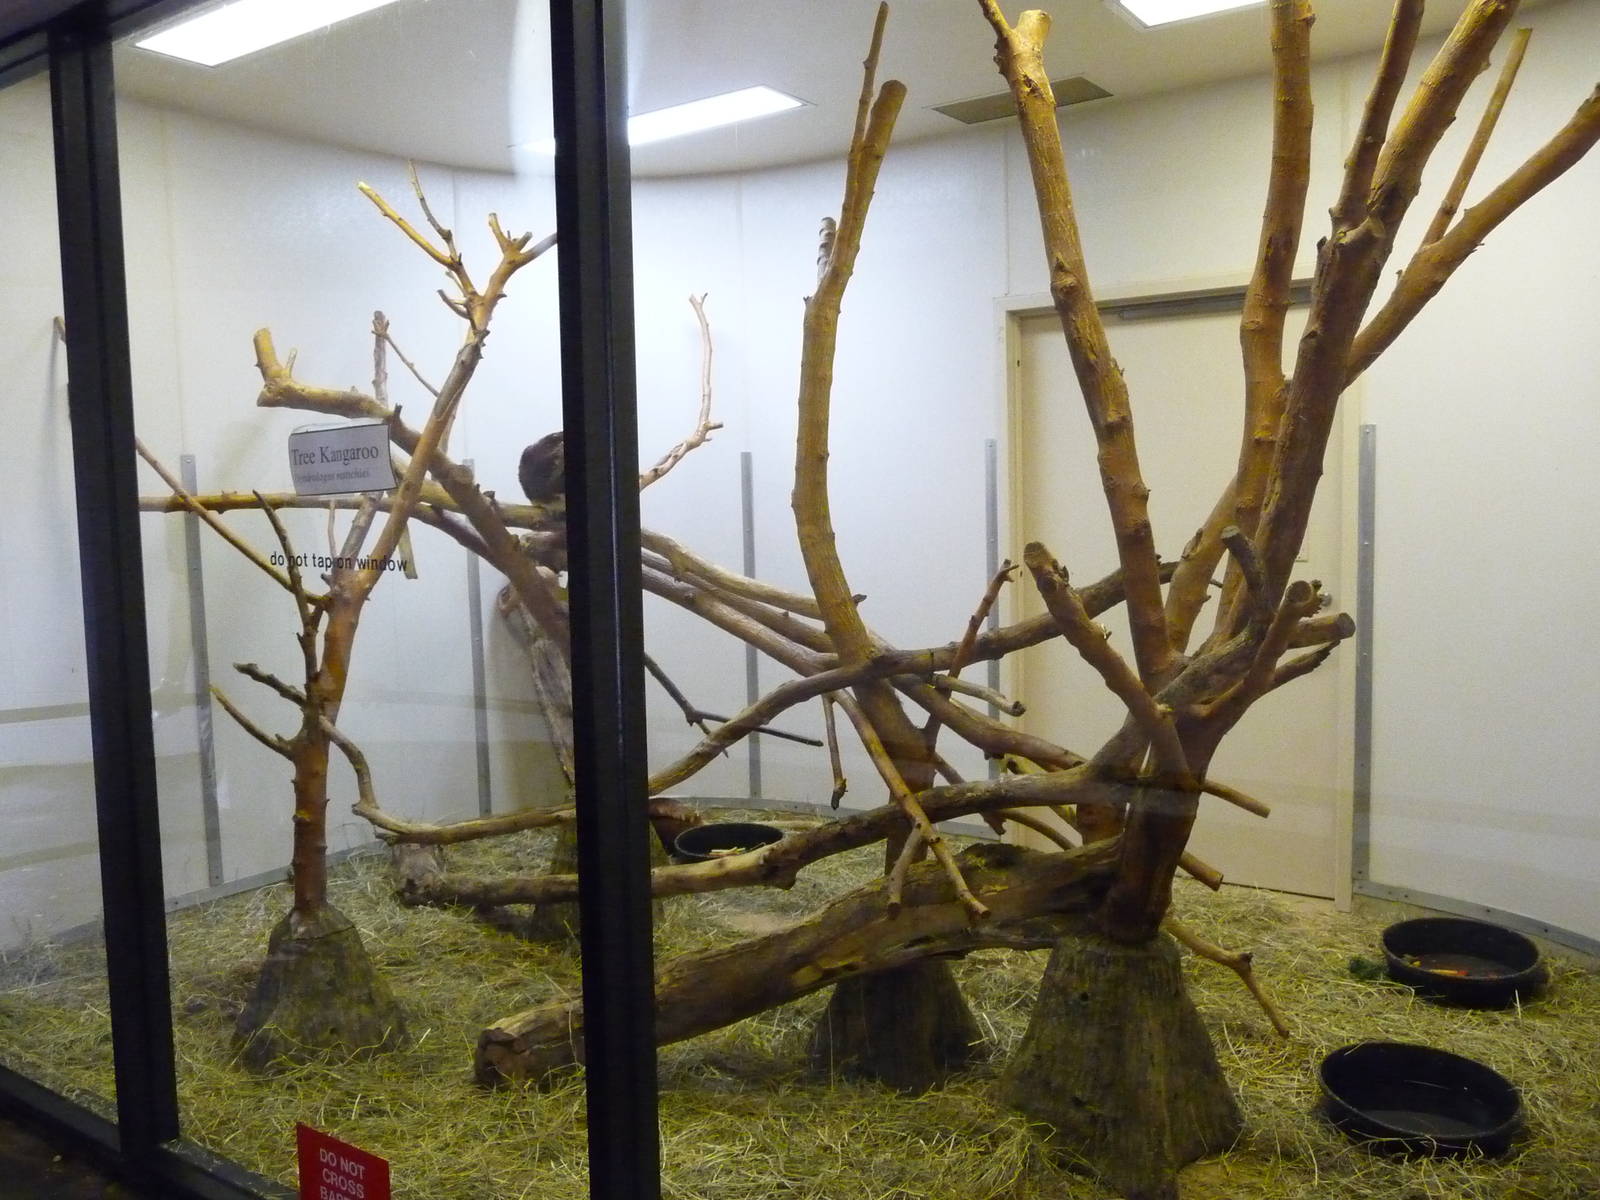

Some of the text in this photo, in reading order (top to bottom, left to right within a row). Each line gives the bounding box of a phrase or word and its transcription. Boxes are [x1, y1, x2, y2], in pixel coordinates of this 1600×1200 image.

[291, 445, 379, 466] Tree Kangaroo
[270, 551, 407, 571] do not tap on window
[319, 1148, 365, 1180] DO NOT
[322, 1168, 364, 1199] CROSS
